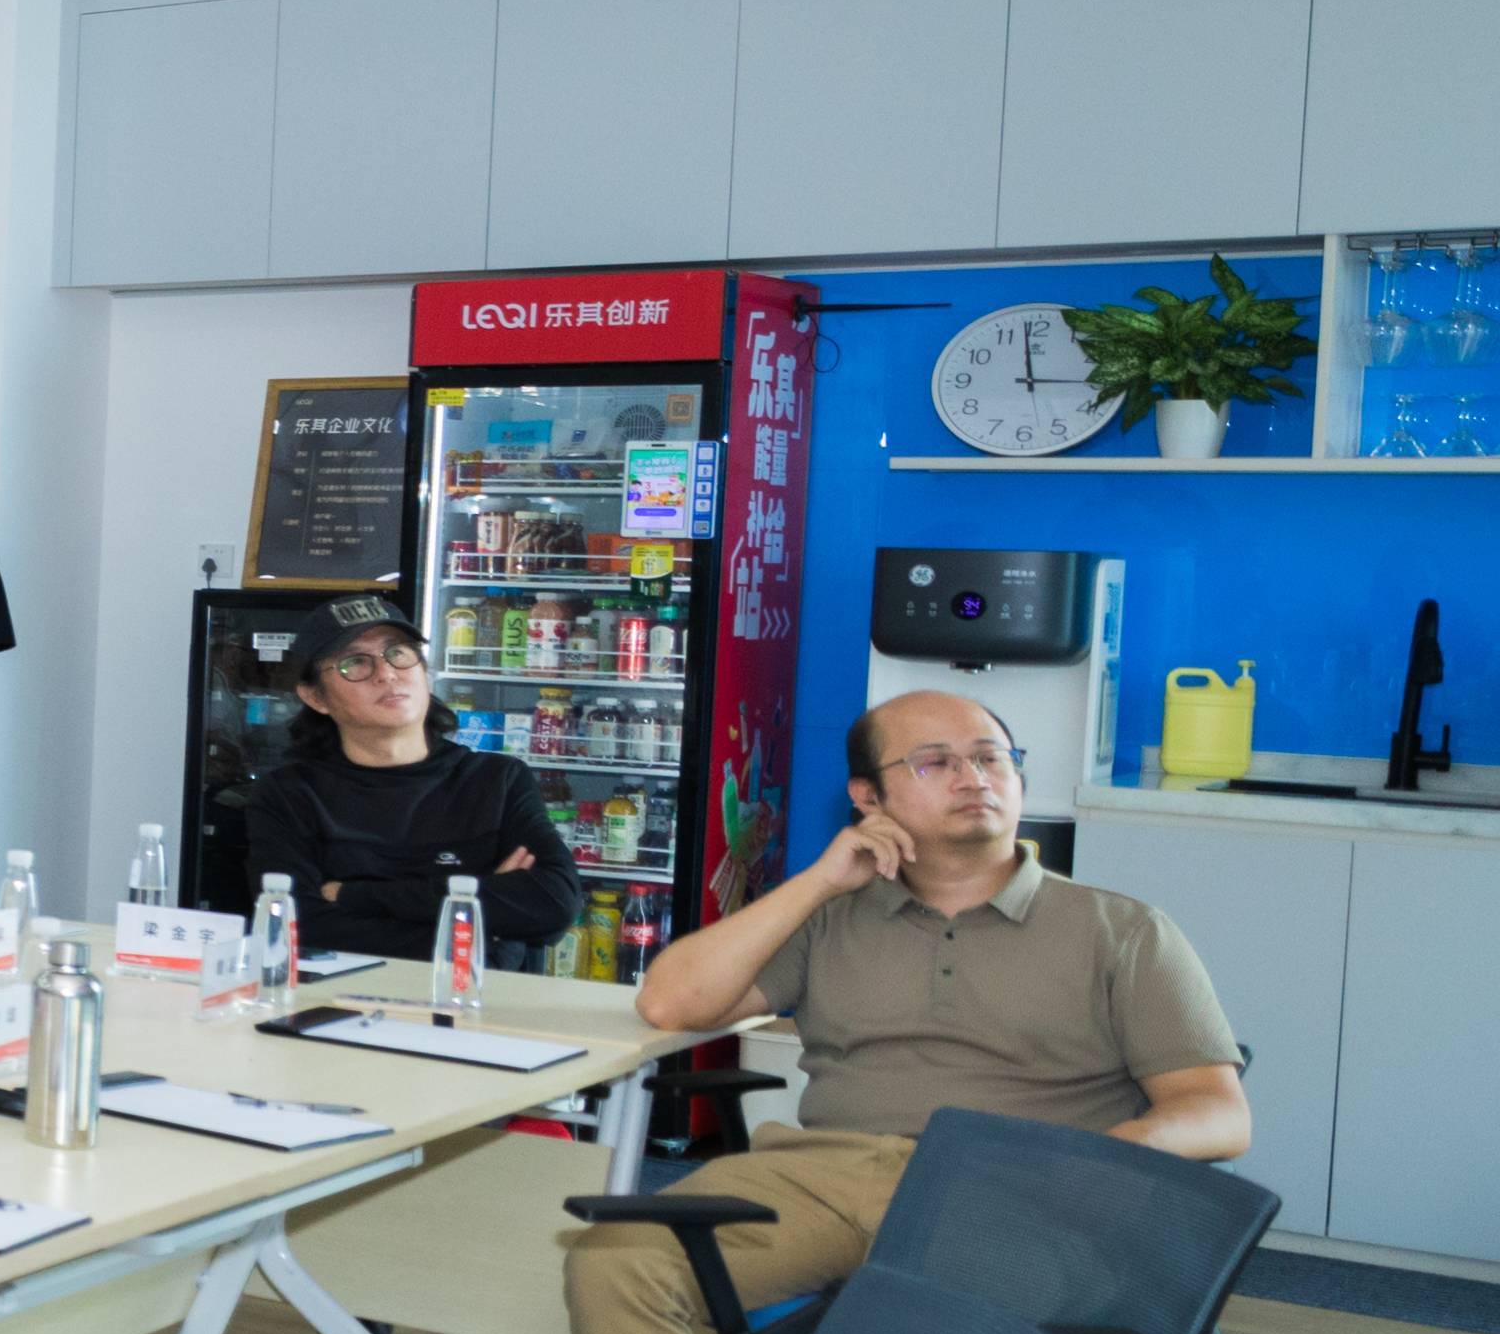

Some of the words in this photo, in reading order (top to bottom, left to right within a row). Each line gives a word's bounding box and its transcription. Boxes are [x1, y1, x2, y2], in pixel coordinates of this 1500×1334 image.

[461, 302, 538, 331] LEQI
[544, 298, 671, 329] 乐其创新
[997, 328, 1014, 345] 11
[970, 348, 992, 365] 10
[954, 372, 972, 389] 9
[962, 398, 978, 415] 8
[294, 418, 394, 435] 乐其企业文化
[987, 418, 1004, 436] 7
[1015, 425, 1033, 443] 6
[1051, 418, 1068, 436] 5
